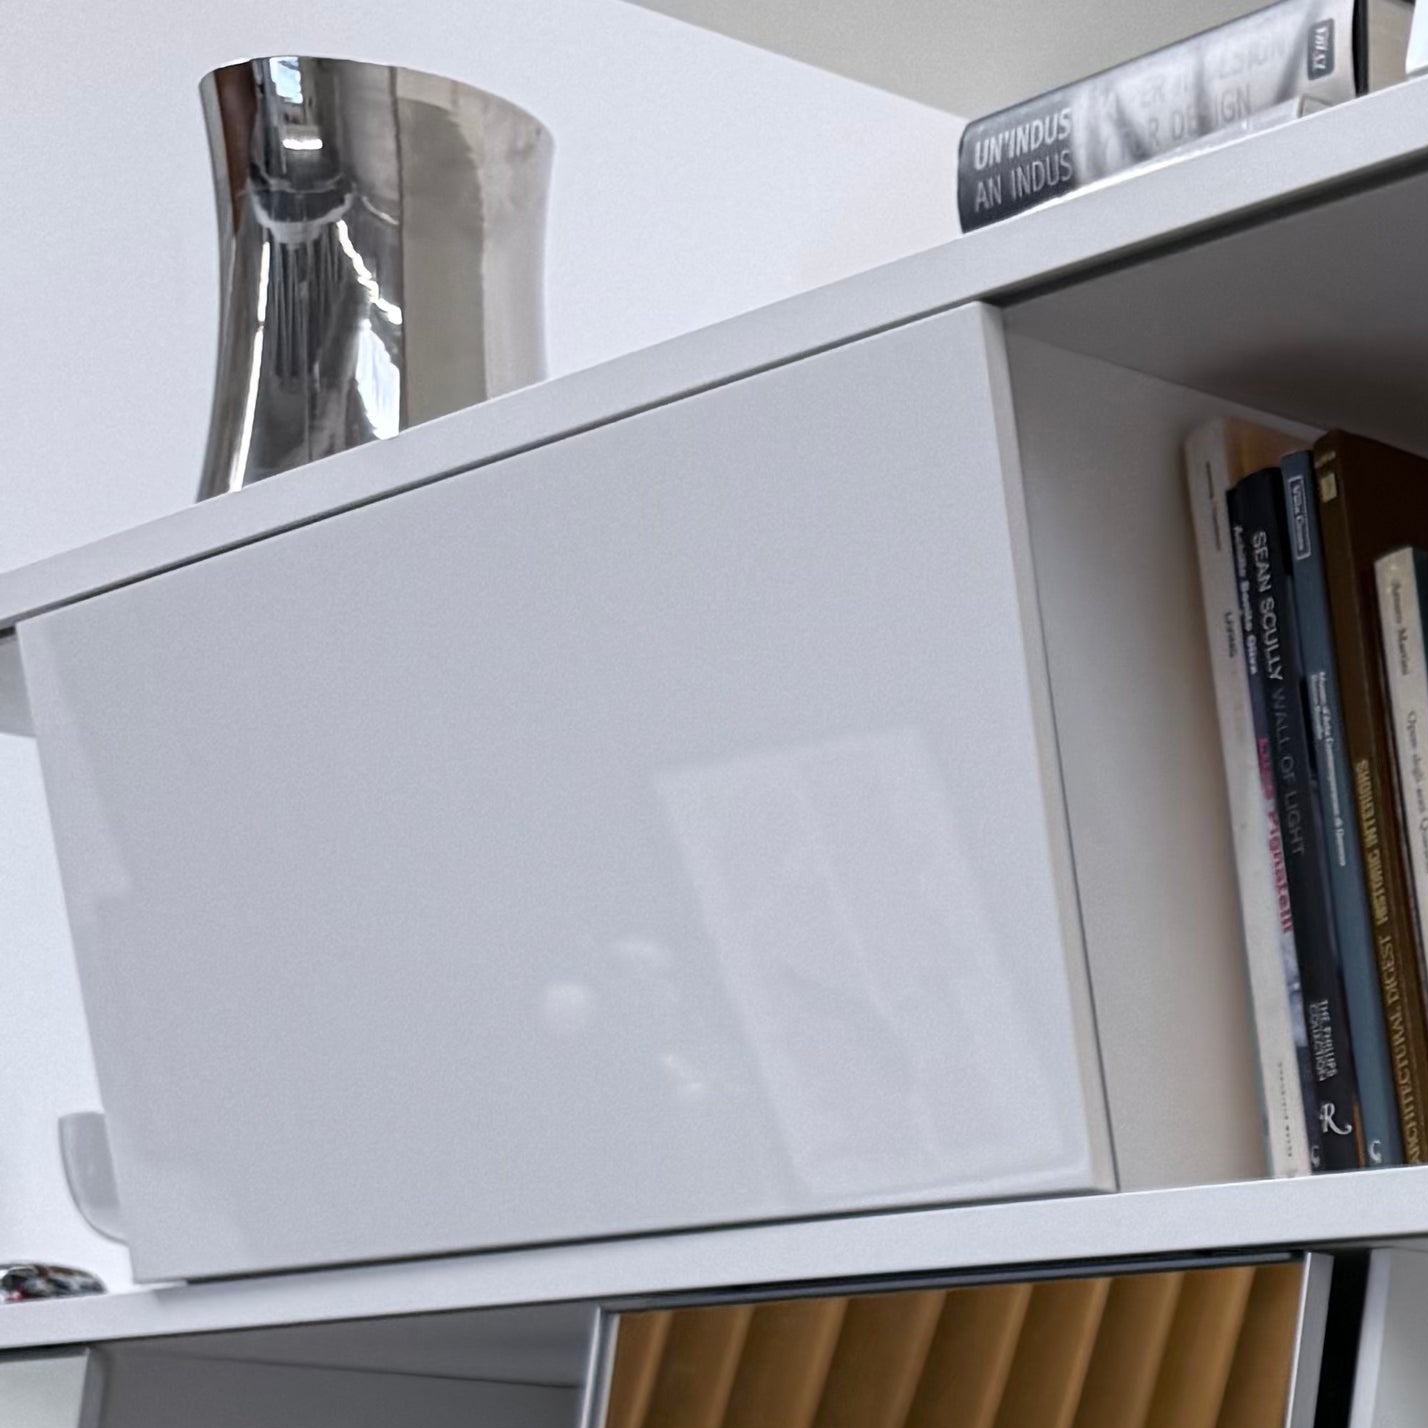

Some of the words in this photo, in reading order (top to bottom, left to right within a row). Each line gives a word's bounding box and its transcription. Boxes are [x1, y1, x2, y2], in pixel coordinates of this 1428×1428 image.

[974, 174, 1003, 213] AN
[1253, 530, 1272, 593] SEAN
[1259, 597, 1283, 681] SCULLY
[1271, 688, 1291, 744] WALL
[1280, 755, 1296, 784] OF
[1356, 759, 1381, 847] INTERIORS
[1283, 791, 1305, 856] LIGHT
[1364, 849, 1389, 926] HISTORIC
[1378, 934, 1400, 1003] DIGEST
[1389, 1005, 1420, 1163] ARCHITECTURAL
